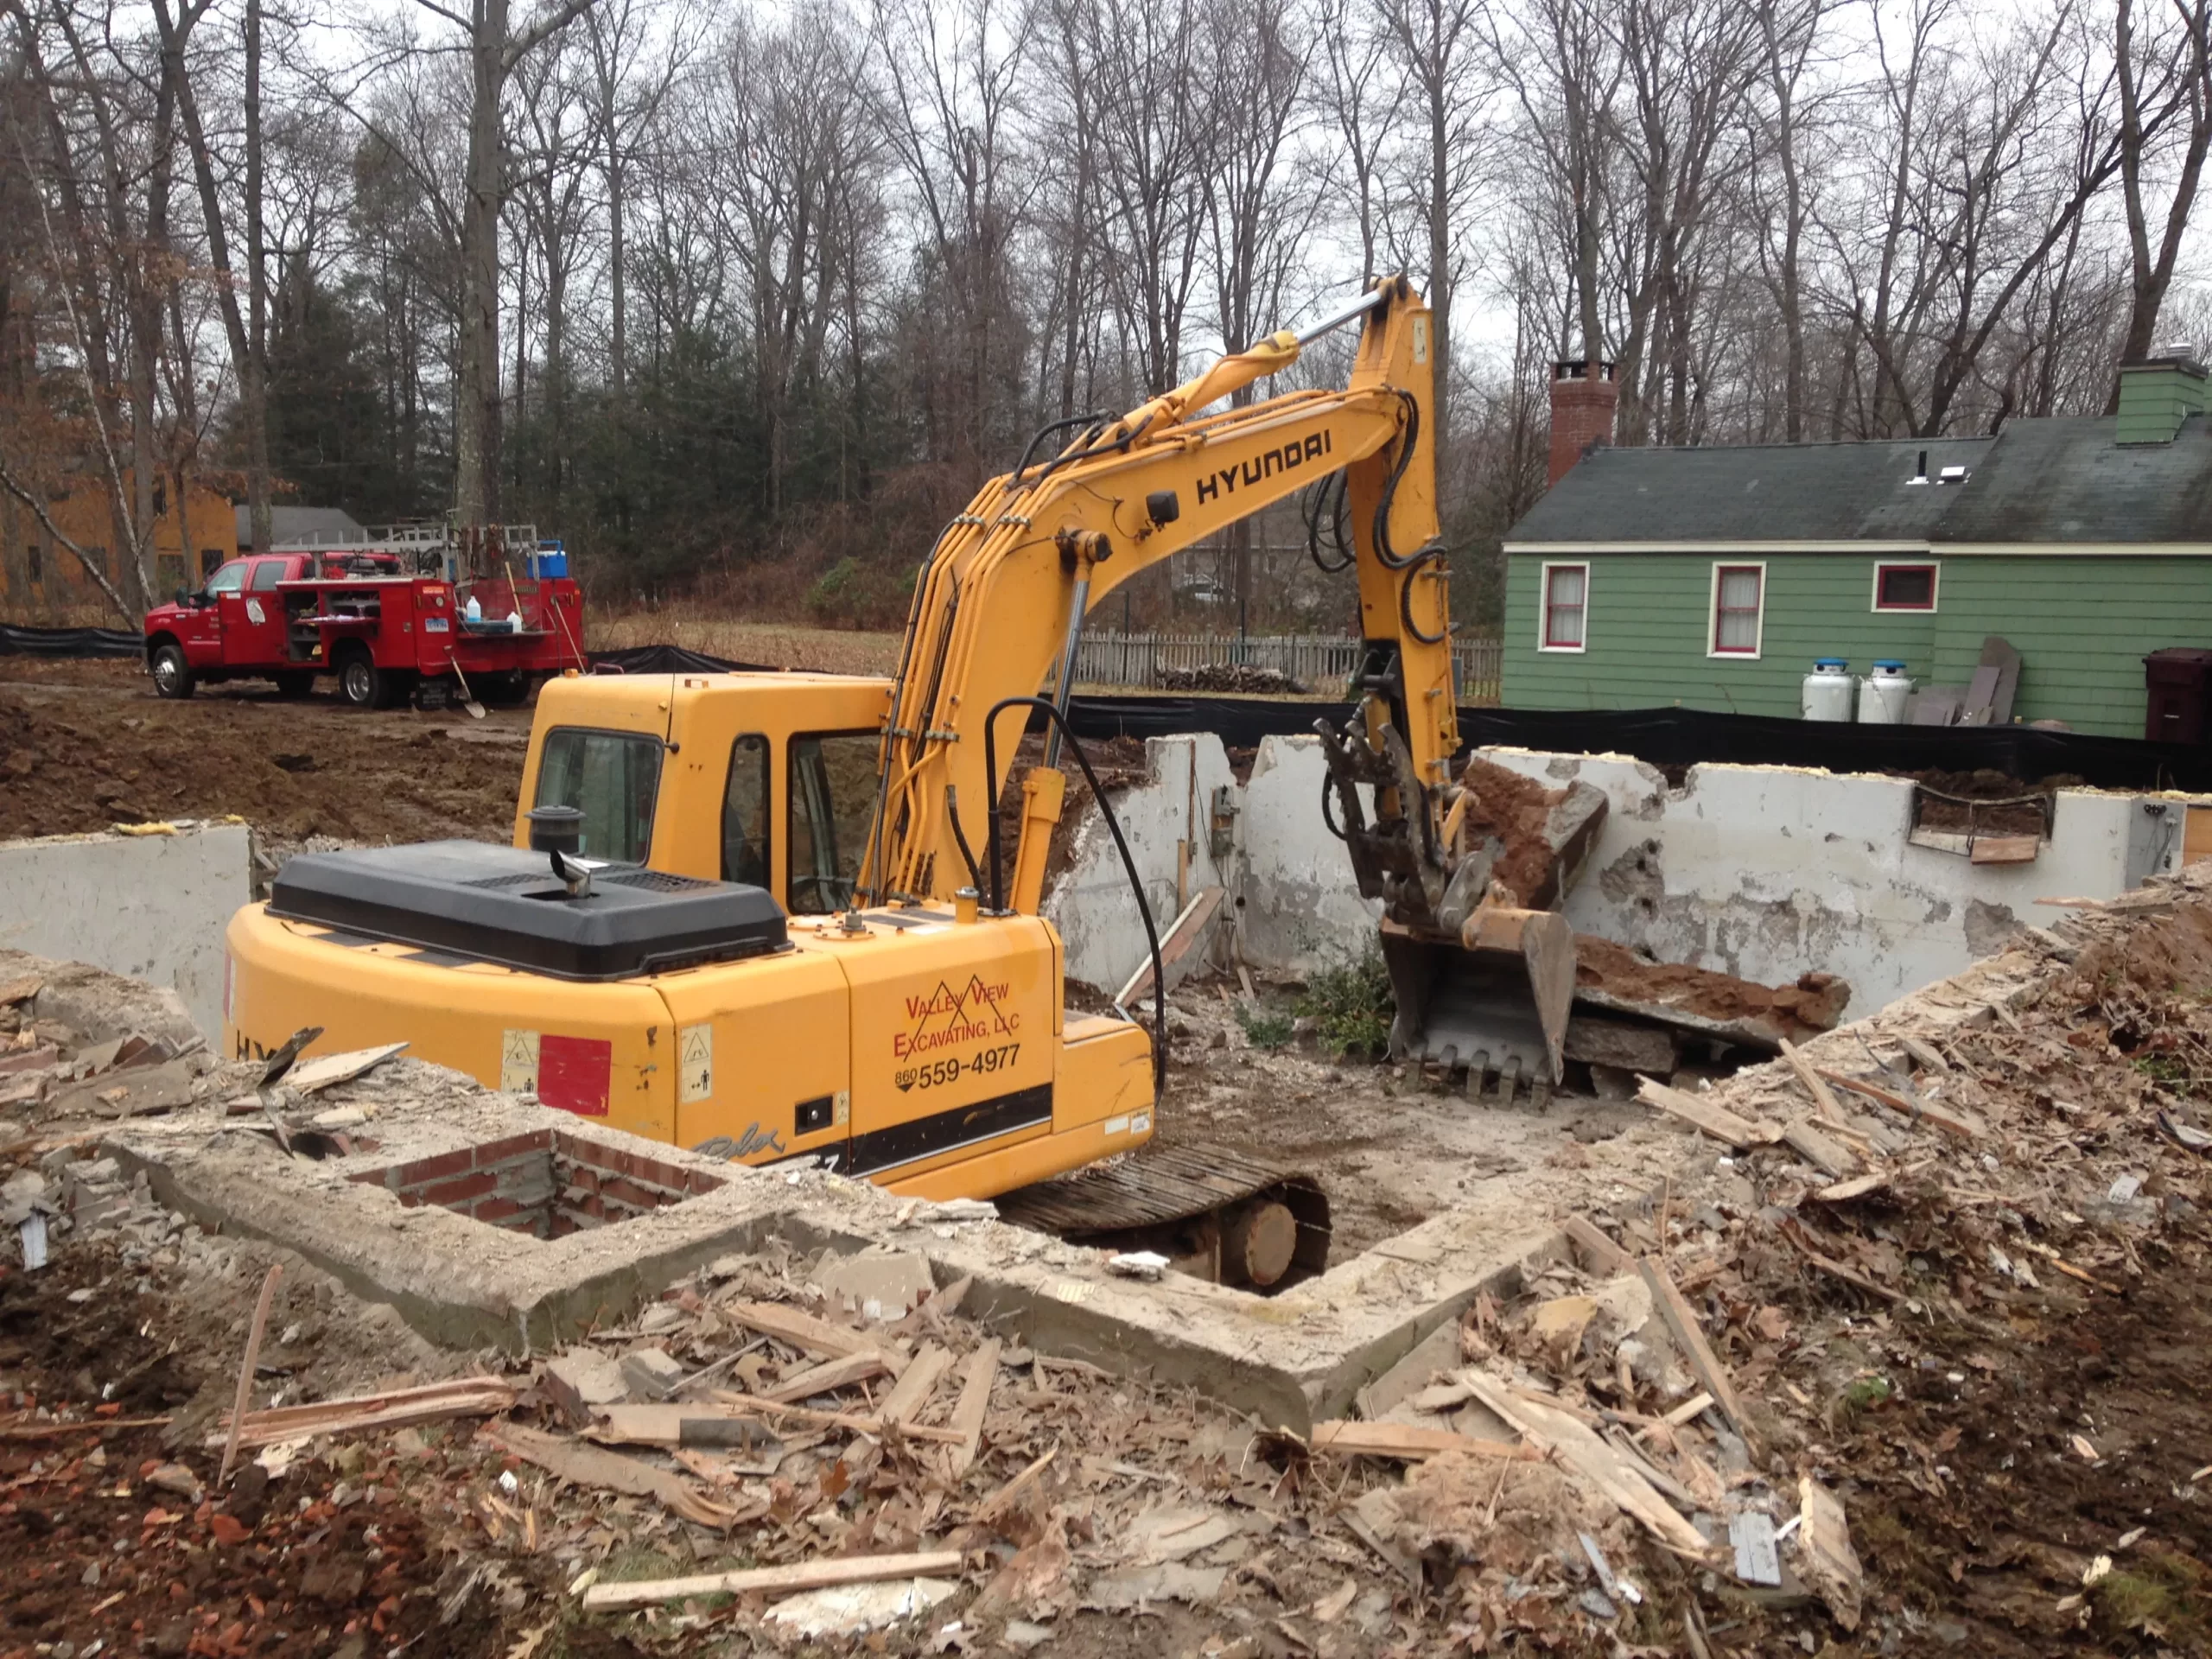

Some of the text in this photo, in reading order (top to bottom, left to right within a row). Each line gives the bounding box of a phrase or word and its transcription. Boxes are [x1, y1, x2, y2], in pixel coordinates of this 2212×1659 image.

[1197, 429, 1332, 505] HYUNDAI
[906, 982, 1009, 1020] VALLEY VIEW
[893, 1013, 1020, 1058] EXCAVATING, LLC
[894, 1043, 1020, 1089] 860 559-4977
